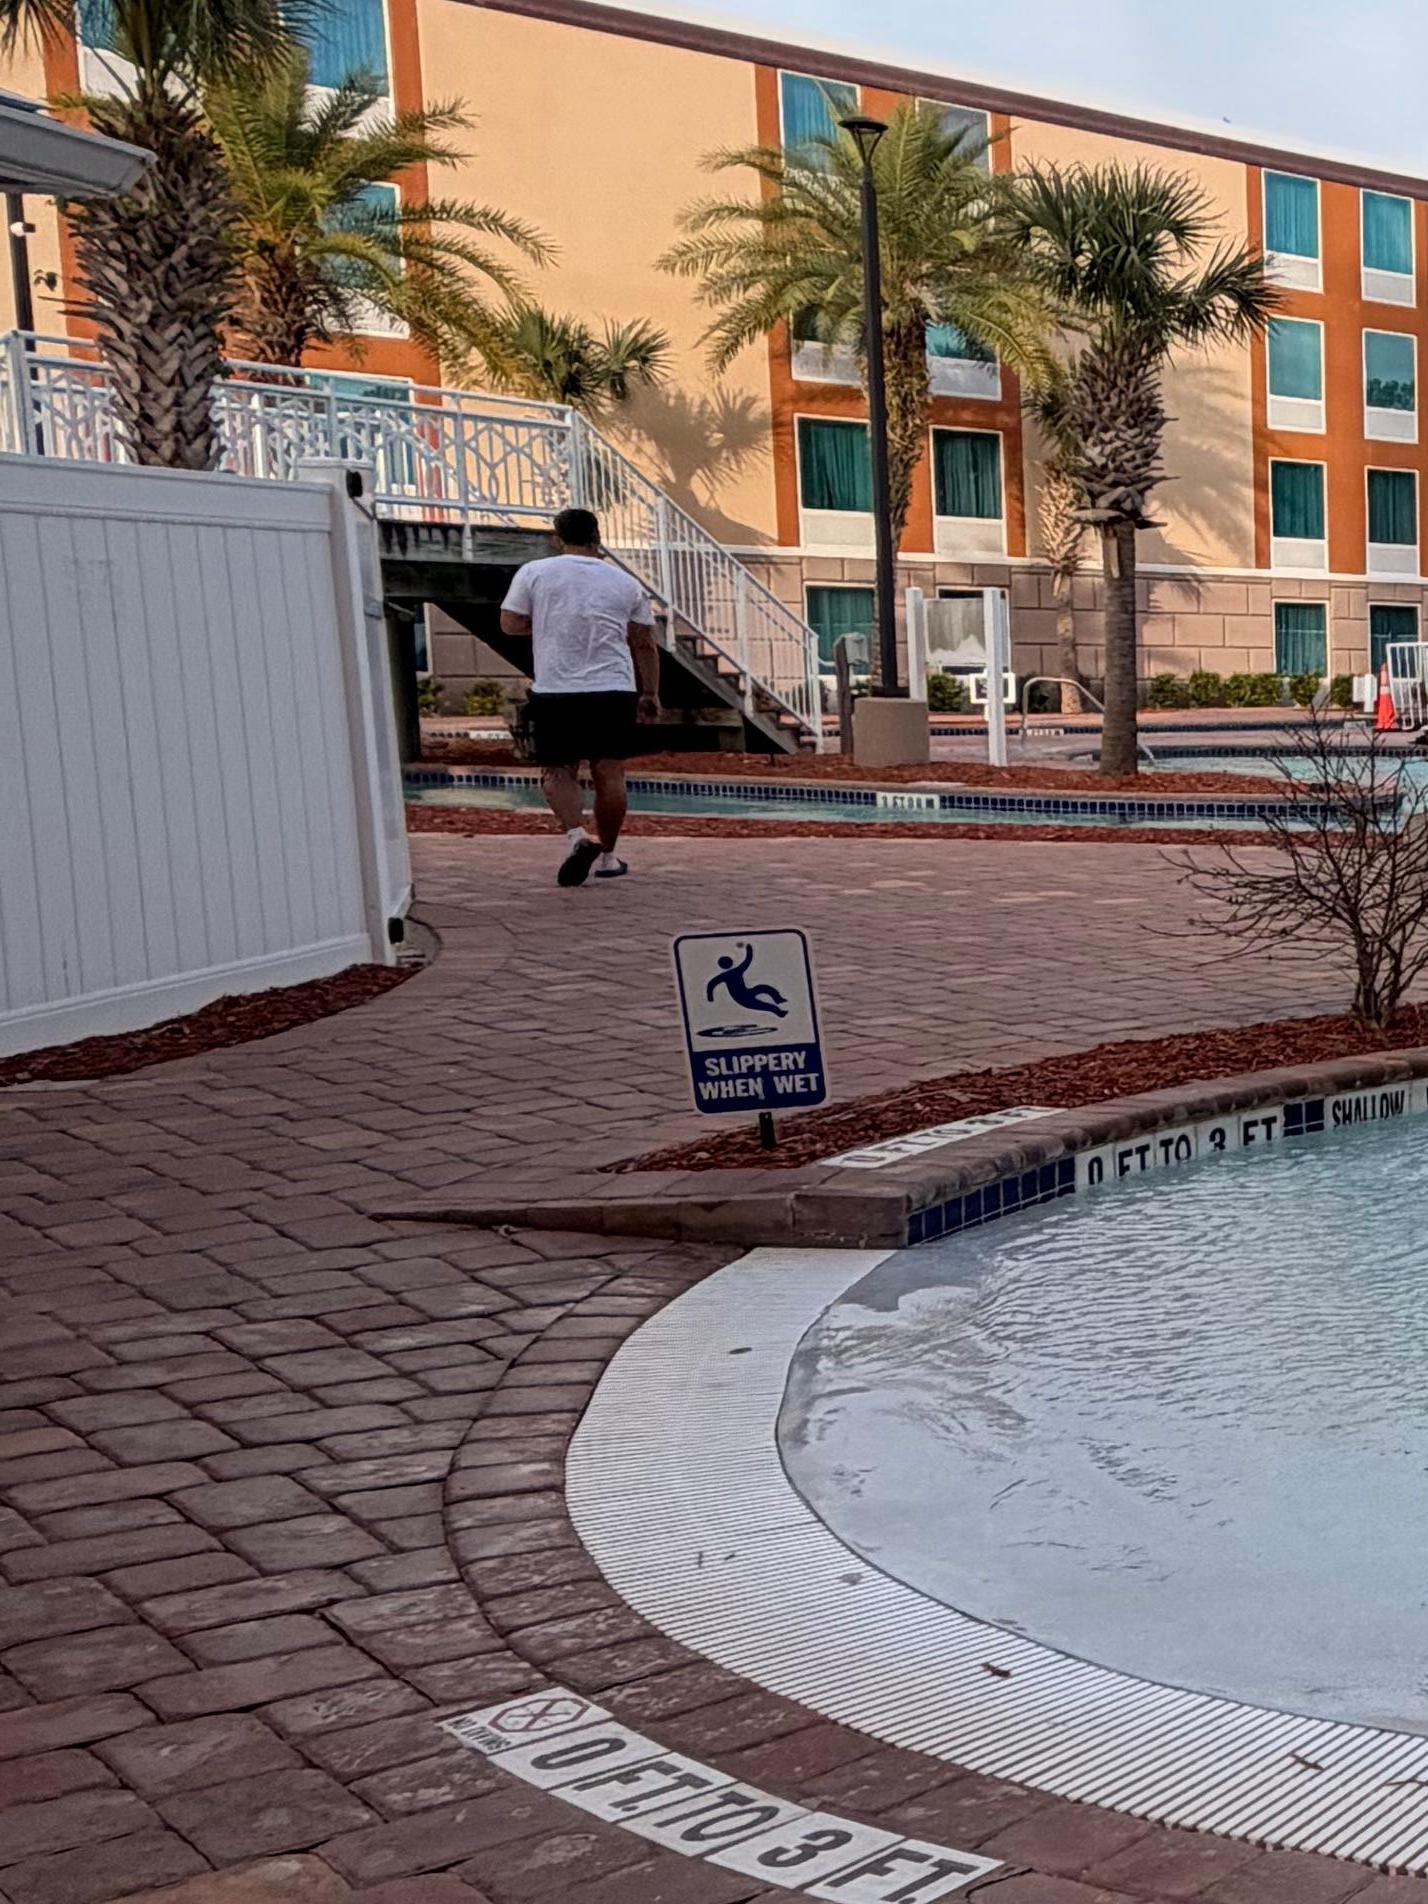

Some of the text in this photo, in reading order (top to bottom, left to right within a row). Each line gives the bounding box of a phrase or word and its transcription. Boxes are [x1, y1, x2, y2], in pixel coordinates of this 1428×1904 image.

[704, 1051, 807, 1077] SLIPPERY
[698, 1073, 820, 1100] WHEN WET
[1332, 1090, 1405, 1127] SHALLOW
[1118, 1144, 1150, 1176] FT
[1158, 1134, 1192, 1165] TO
[1243, 1115, 1278, 1145] FT
[530, 1737, 627, 1770] 0
[653, 1790, 780, 1842] TO
[757, 1829, 853, 1868] 3
